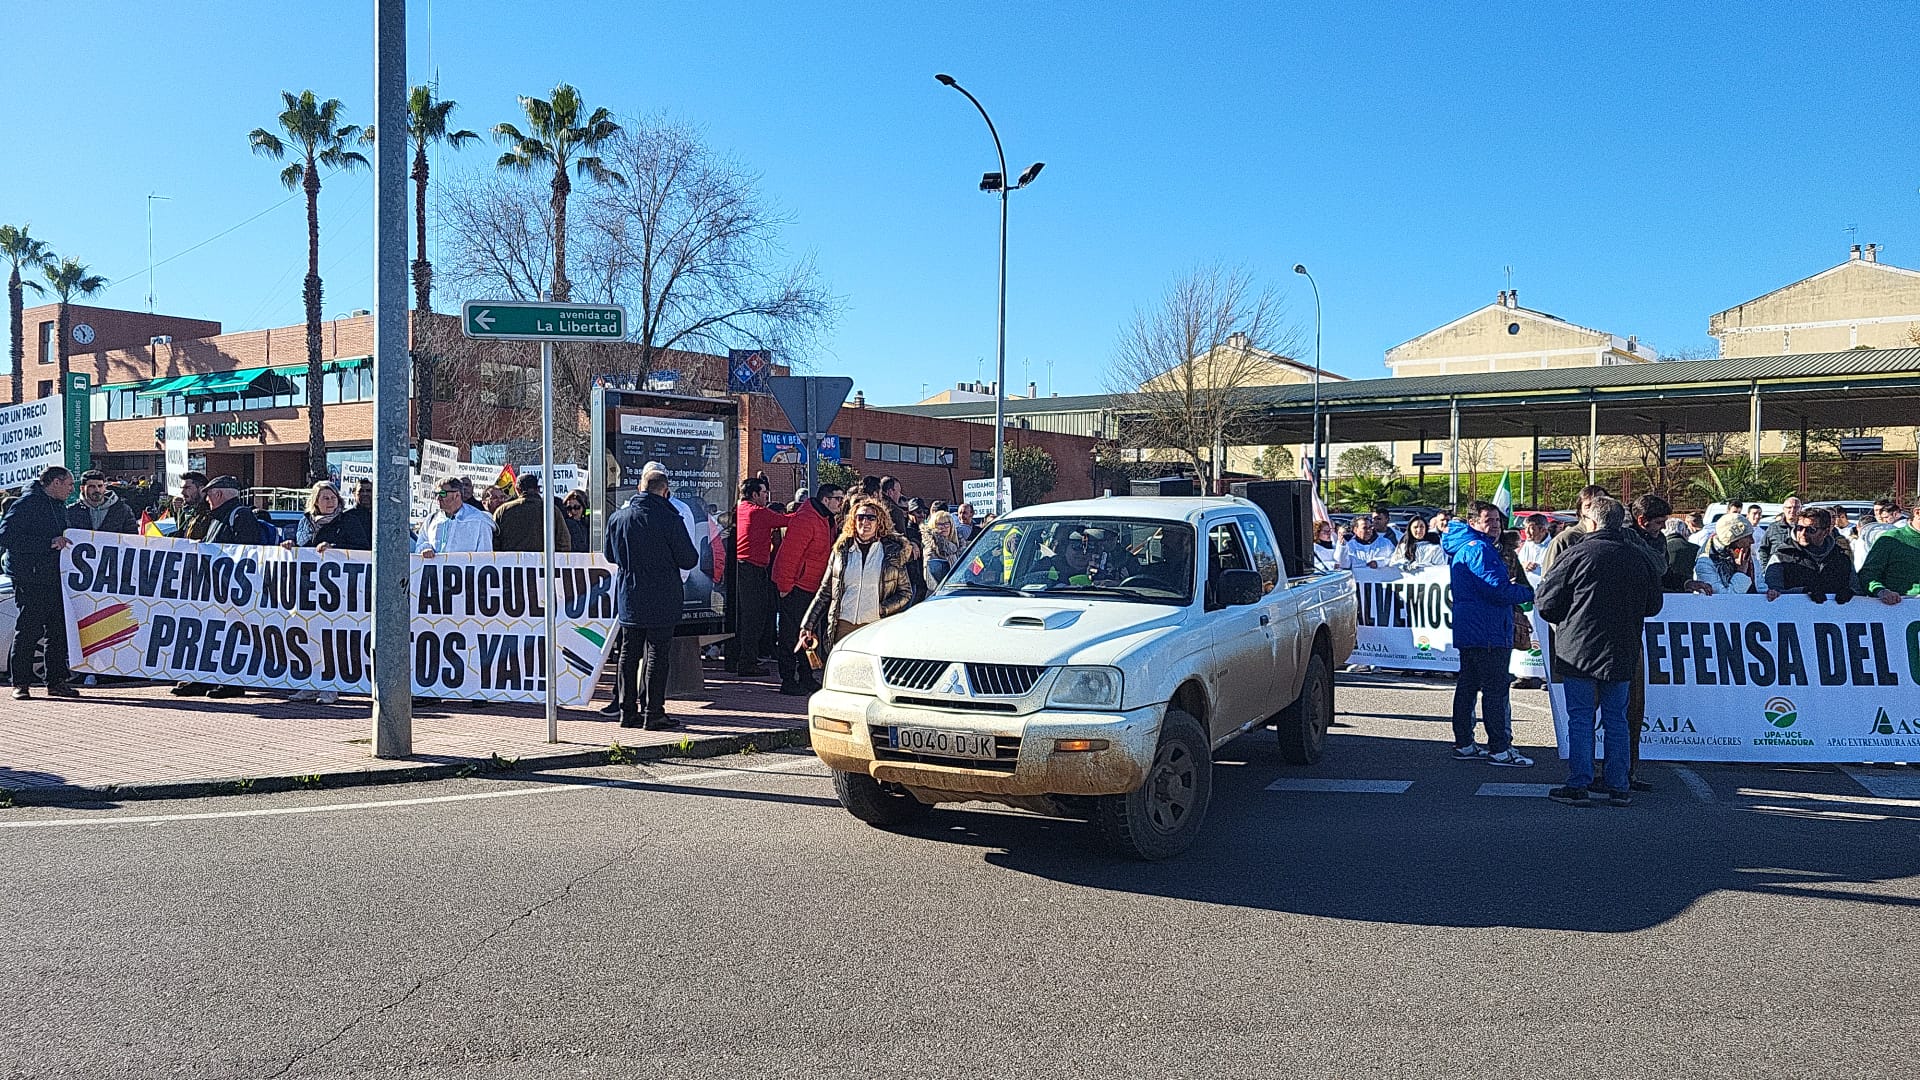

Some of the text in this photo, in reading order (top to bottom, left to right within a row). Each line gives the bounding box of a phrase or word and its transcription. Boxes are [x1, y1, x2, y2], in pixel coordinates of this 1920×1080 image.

[560, 310, 617, 320] avenida de
[537, 320, 617, 333] La Libertad
[0, 403, 47, 426] OR UN PRECIO
[73, 400, 81, 438] Autobuses
[1, 424, 43, 445] JUSTO PARA
[195, 424, 206, 437] DE
[210, 421, 259, 437] AUTOBUSES
[676, 429, 715, 437] EMPRESARIAL
[74, 440, 81, 450] de
[762, 433, 780, 445] COME
[782, 434, 787, 445] Y
[789, 434, 801, 445] BEB
[0, 440, 62, 465] TROS PRODUCTOS
[349, 465, 374, 473] CUIDA
[553, 470, 574, 479] ESTRA
[6, 471, 15, 484] LA
[68, 543, 618, 619] SALVEMOS NUEST APICULUR
[1356, 582, 1454, 629] LVEMOS
[145, 615, 313, 681] PRECIOS
[1360, 642, 1389, 653] ASAJA
[1642, 620, 1809, 687] EFENSA
[1813, 622, 1899, 686] DEL
[1640, 717, 1697, 732] SAJA
[1707, 734, 1743, 746] CÁCERES
[1764, 731, 1803, 739] UPA-UCE
[901, 730, 947, 750] 0040
[956, 735, 991, 756] DJK
[1753, 739, 1815, 747] EXTREMADURA
[1827, 737, 1847, 747] APAG
[1848, 738, 1906, 747] EXTREMADURA
